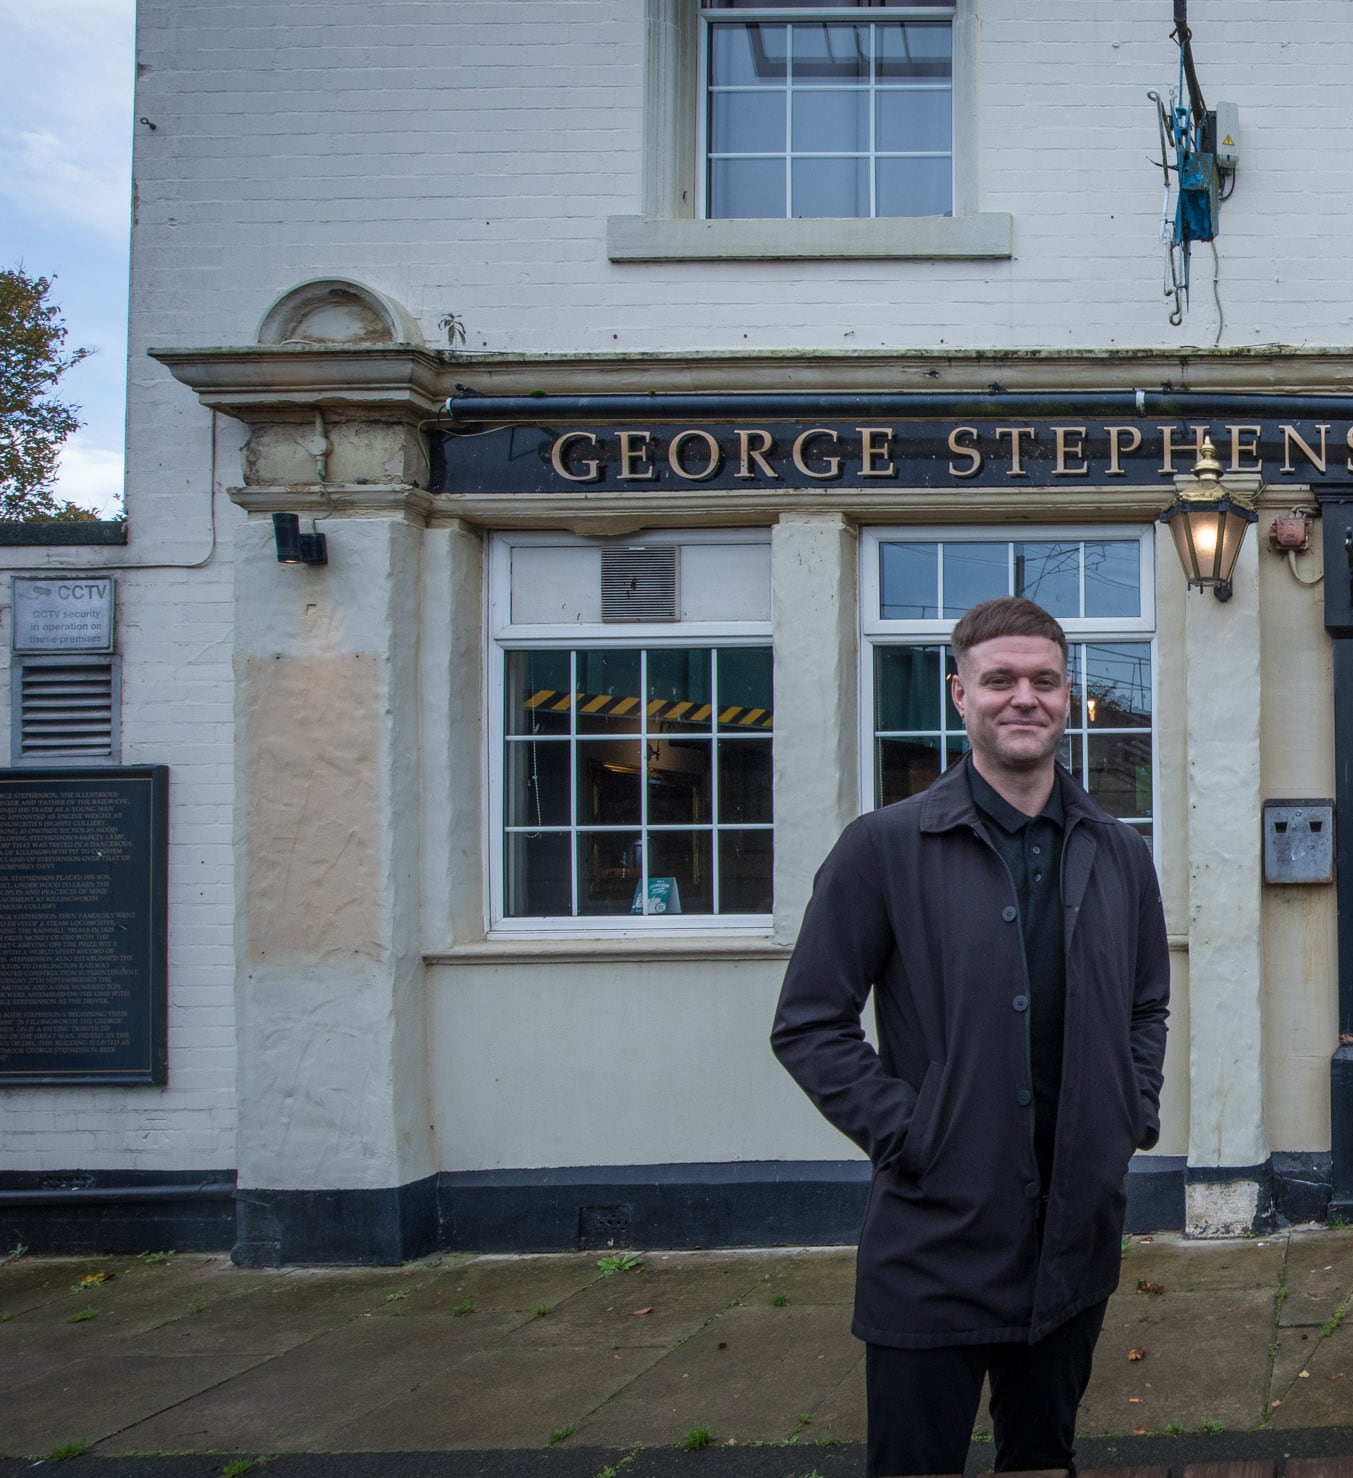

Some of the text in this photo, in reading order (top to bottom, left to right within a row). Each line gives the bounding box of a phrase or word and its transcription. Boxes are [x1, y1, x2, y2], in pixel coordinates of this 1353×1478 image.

[551, 427, 895, 481] GEORGE
[58, 584, 106, 600] CCTV
[32, 608, 101, 620] CCTV security
[30, 622, 102, 633] in operation on
[30, 635, 102, 644] these premises
